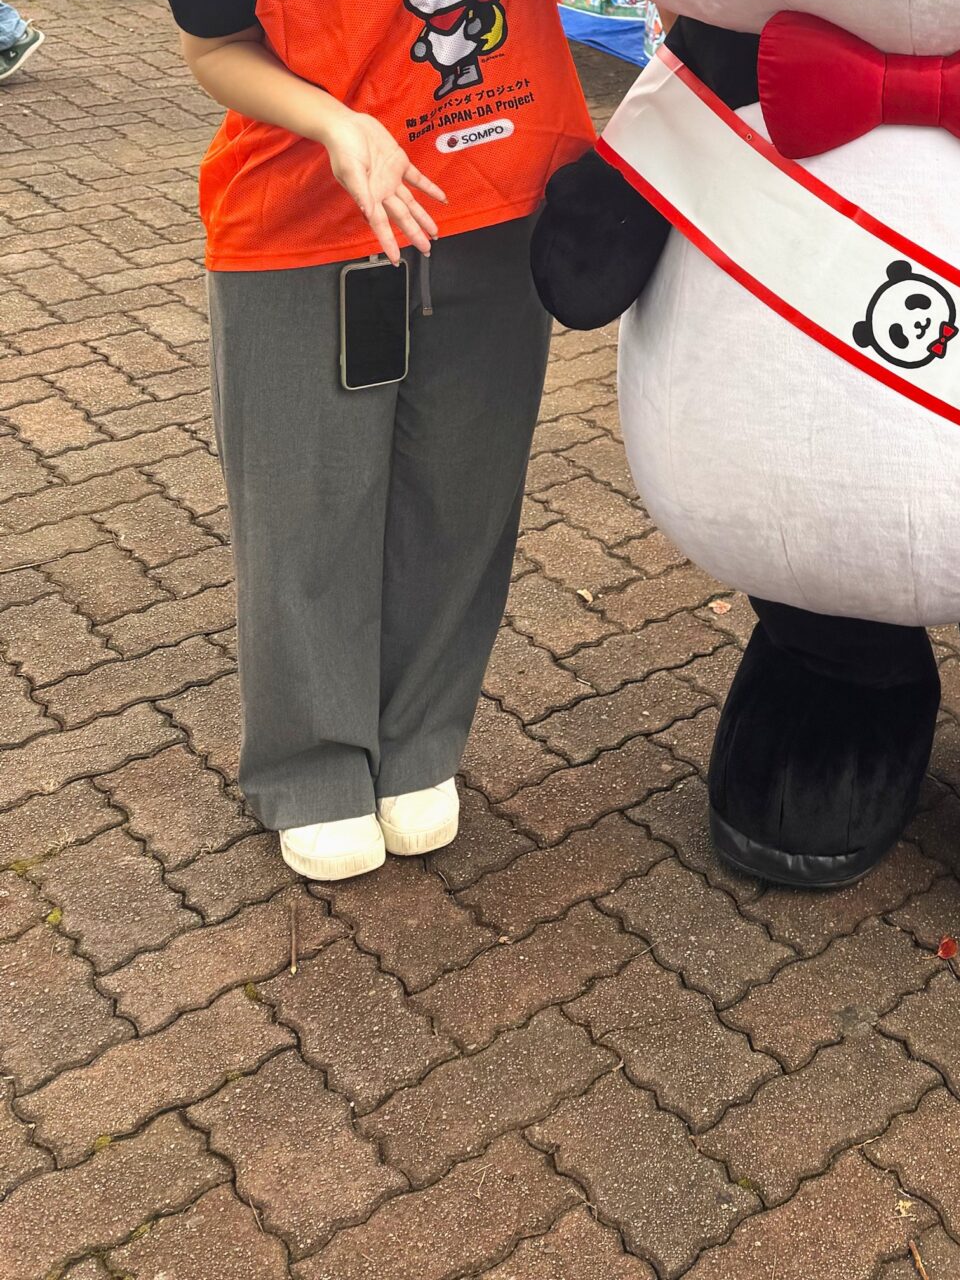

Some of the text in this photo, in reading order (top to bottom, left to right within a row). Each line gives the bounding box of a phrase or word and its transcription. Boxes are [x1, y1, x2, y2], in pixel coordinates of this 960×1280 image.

[475, 78, 531, 99] プロジェクト
[408, 91, 535, 142] Bosai JAPAN-DA Project
[461, 125, 504, 145] SOMPO
